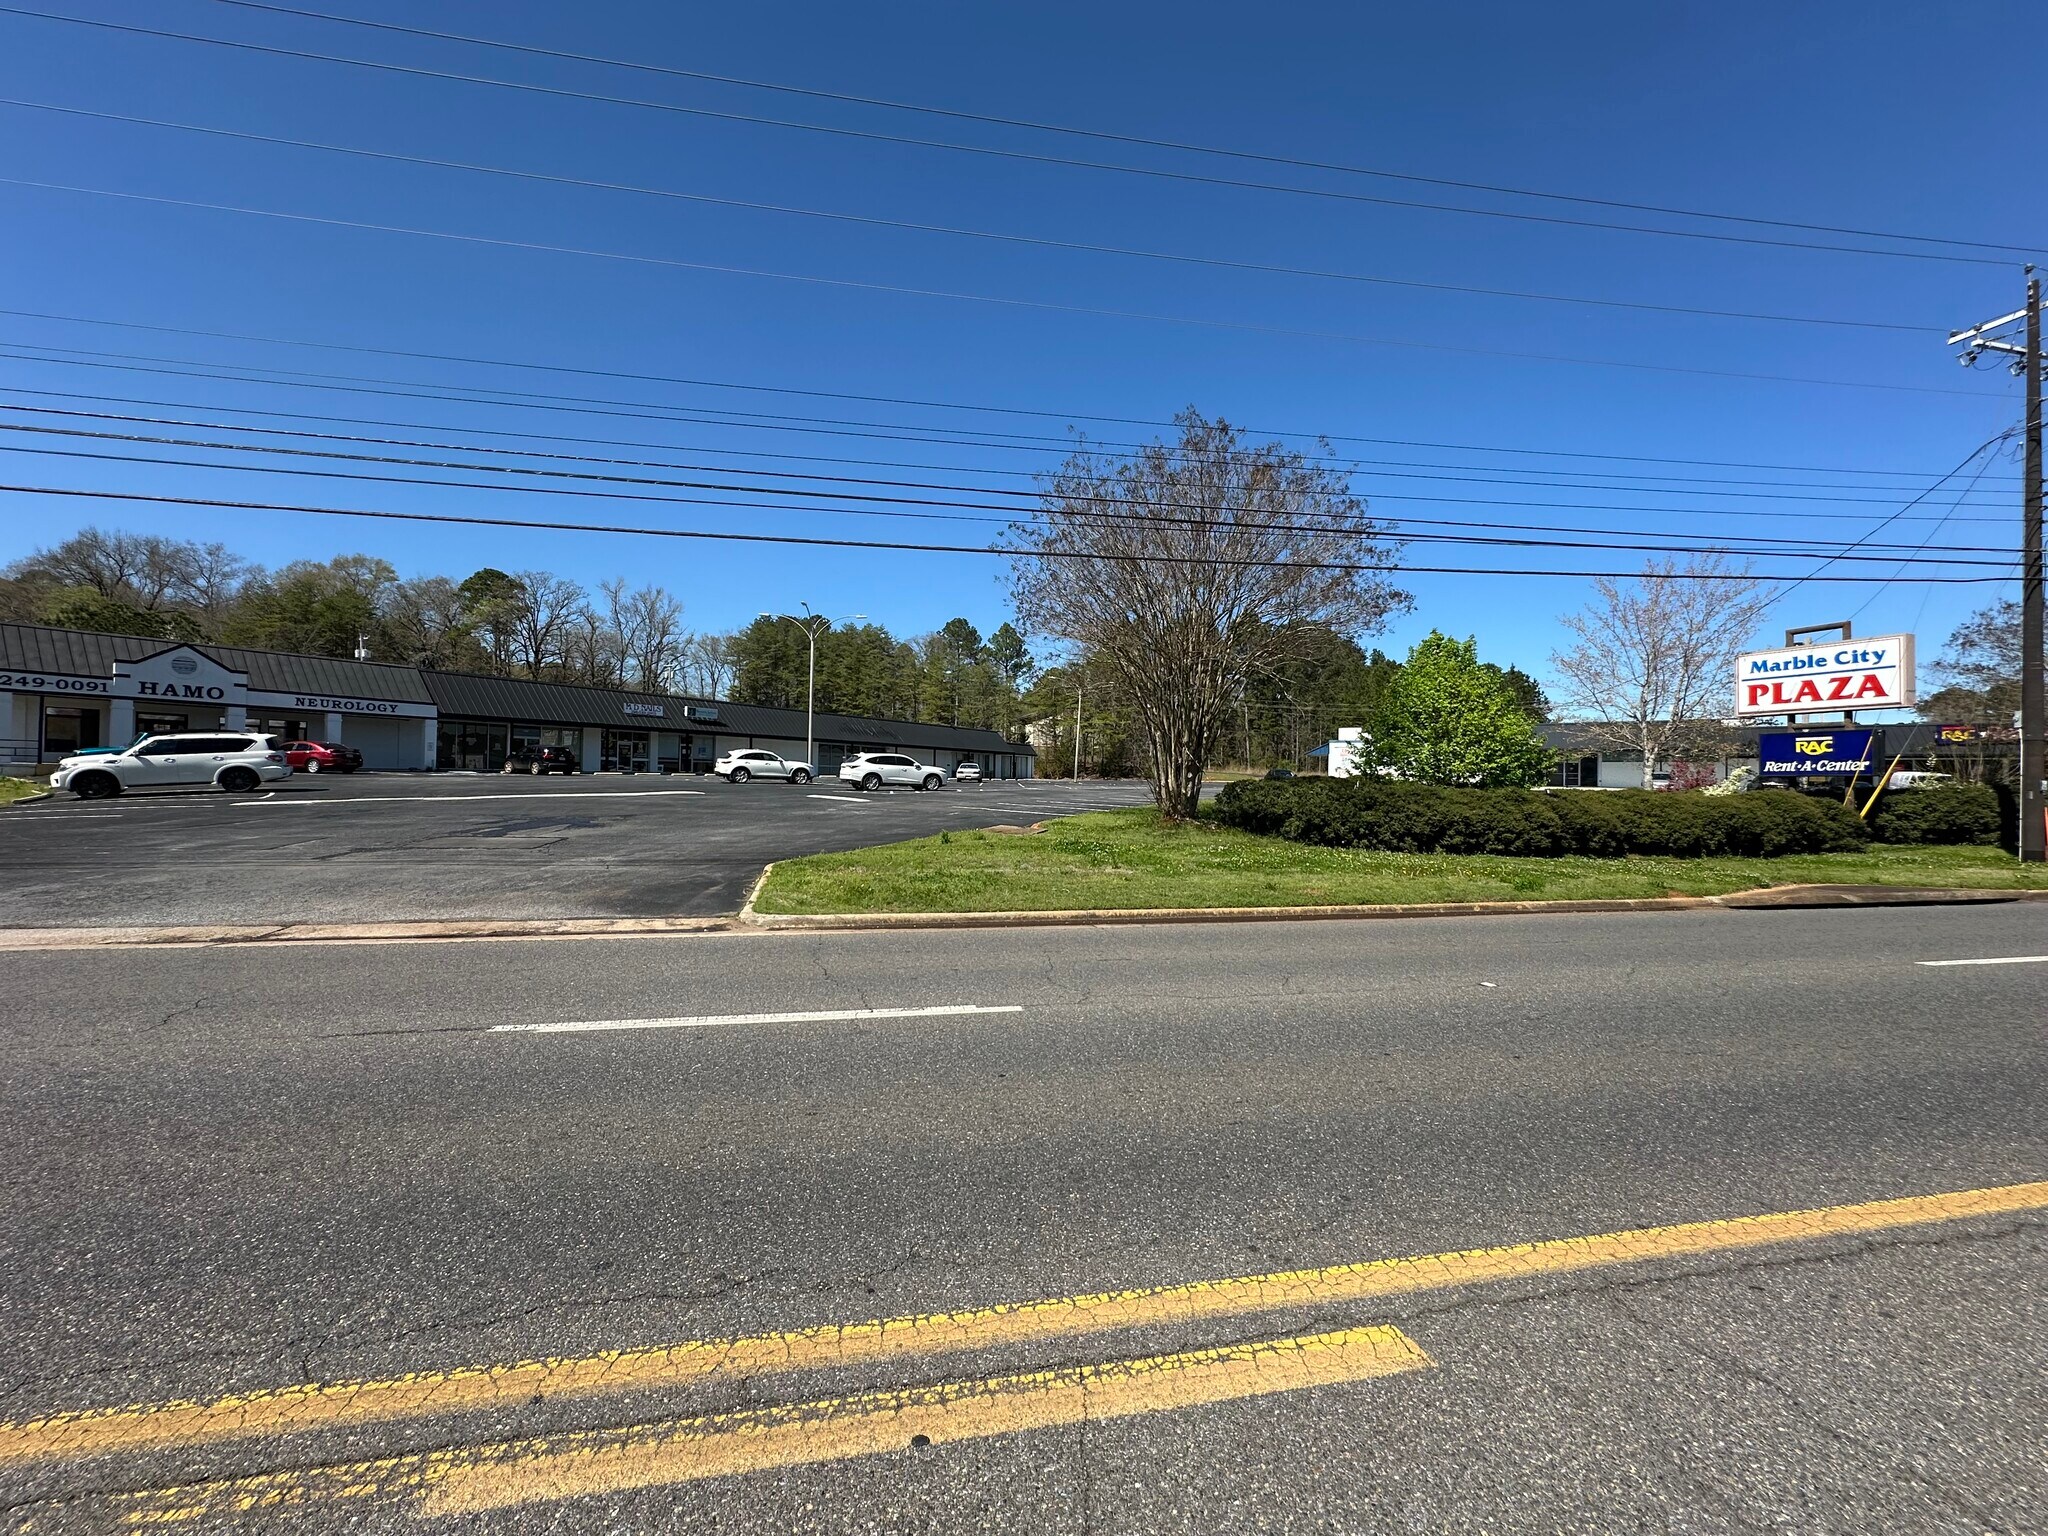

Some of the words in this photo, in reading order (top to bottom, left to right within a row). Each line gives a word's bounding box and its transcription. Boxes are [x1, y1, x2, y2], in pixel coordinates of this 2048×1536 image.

[1750, 655, 1827, 674] Marble
[1834, 650, 1886, 665] City
[0, 675, 109, 693] 249-0091
[138, 681, 224, 699] HAMO
[1747, 674, 1889, 706] PLAZA
[295, 697, 398, 713] NEUROLOGY
[1795, 740, 1833, 755] RAC
